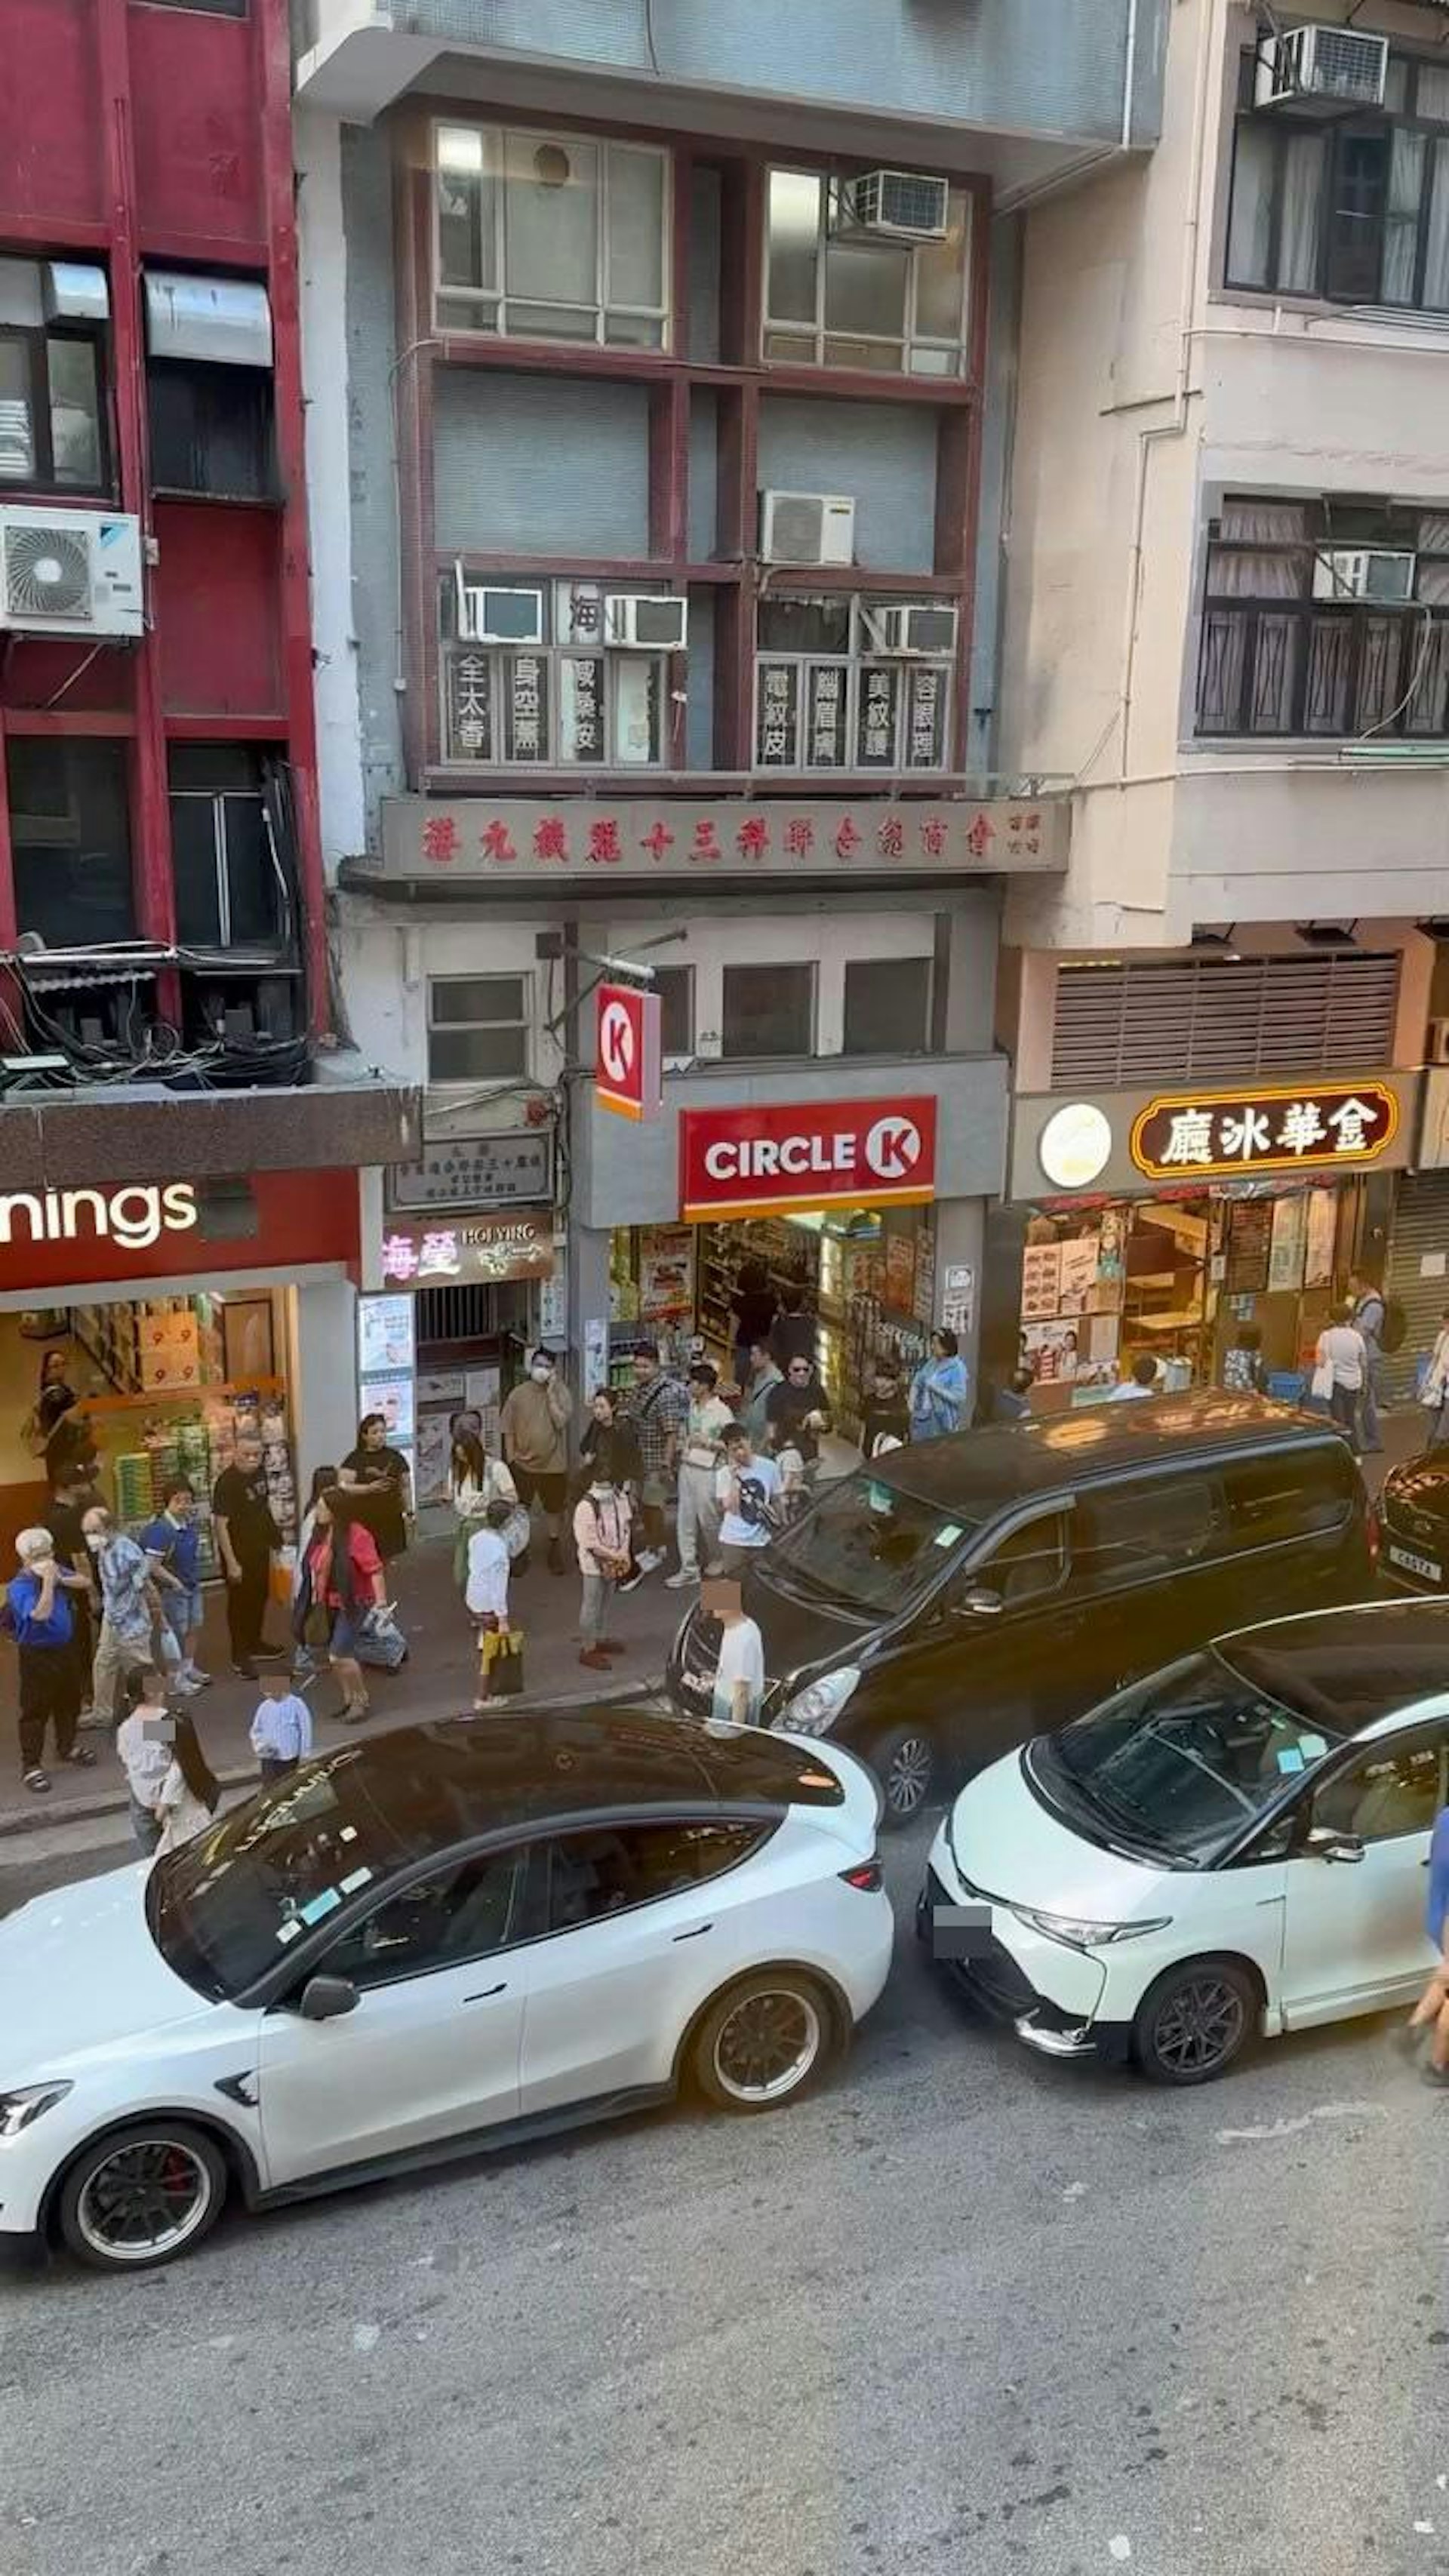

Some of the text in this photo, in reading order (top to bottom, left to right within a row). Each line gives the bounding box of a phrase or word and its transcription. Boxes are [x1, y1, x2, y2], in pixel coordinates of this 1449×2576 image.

[605, 1008, 631, 1082] K
[705, 1121, 921, 1180] CIRCLE K
